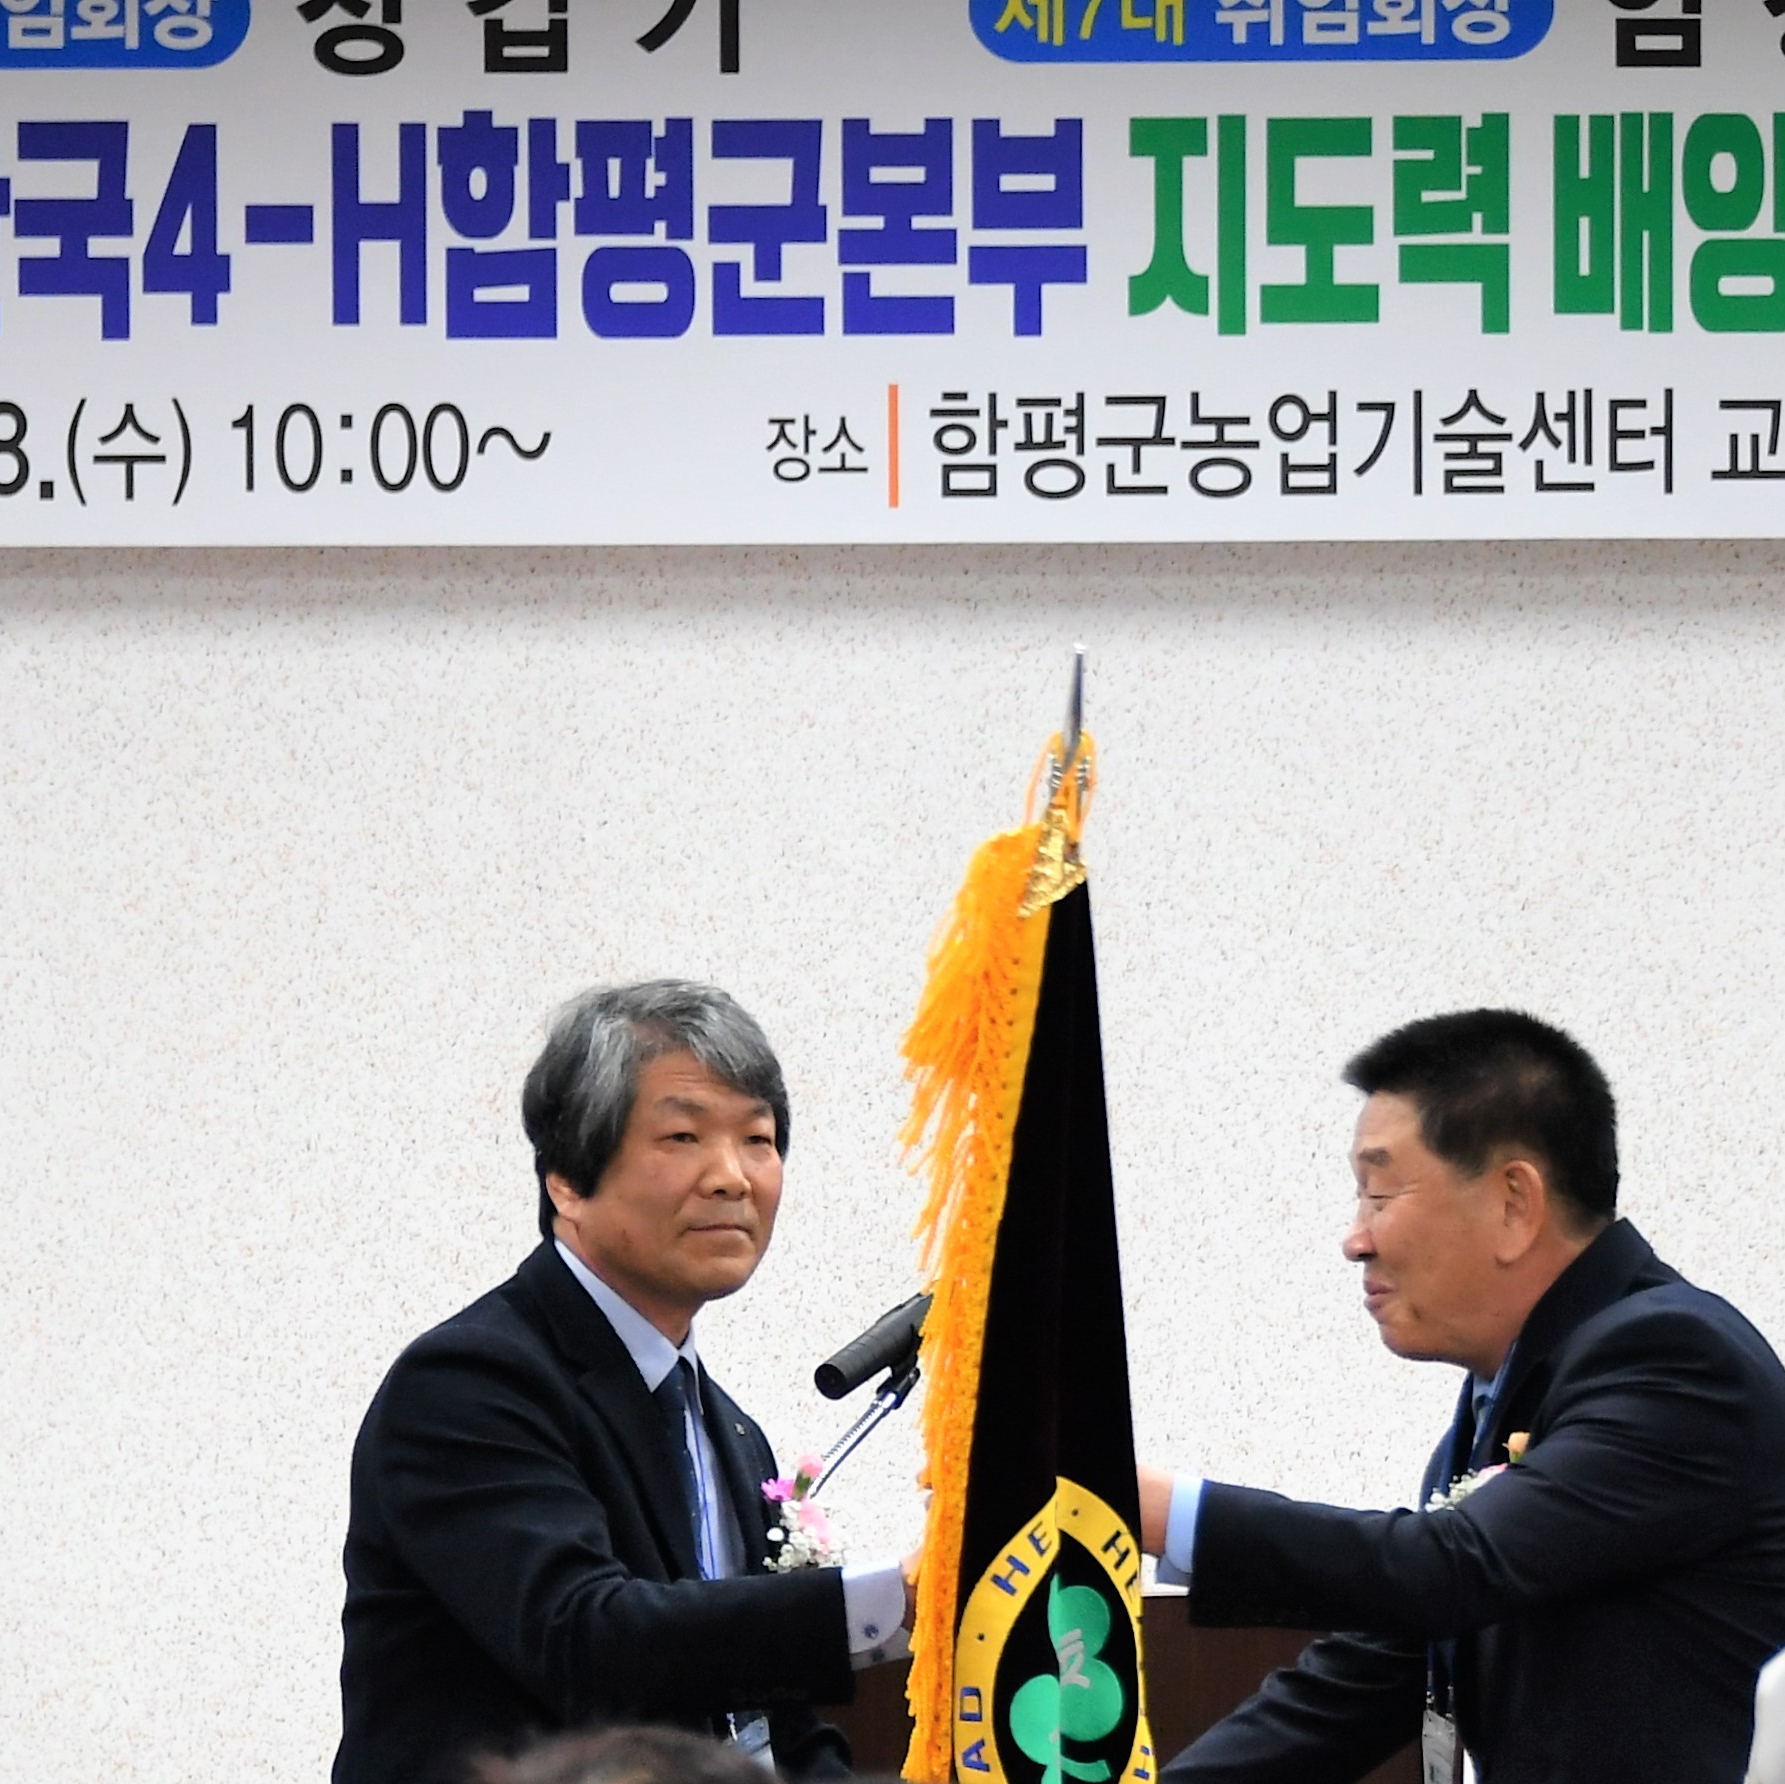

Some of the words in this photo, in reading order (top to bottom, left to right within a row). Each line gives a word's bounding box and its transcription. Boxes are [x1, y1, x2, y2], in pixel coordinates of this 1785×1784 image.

[1127, 113, 1511, 336] 지도력
[765, 413, 870, 482] 장소
[928, 387, 1675, 500] 함평군농업기술센터
